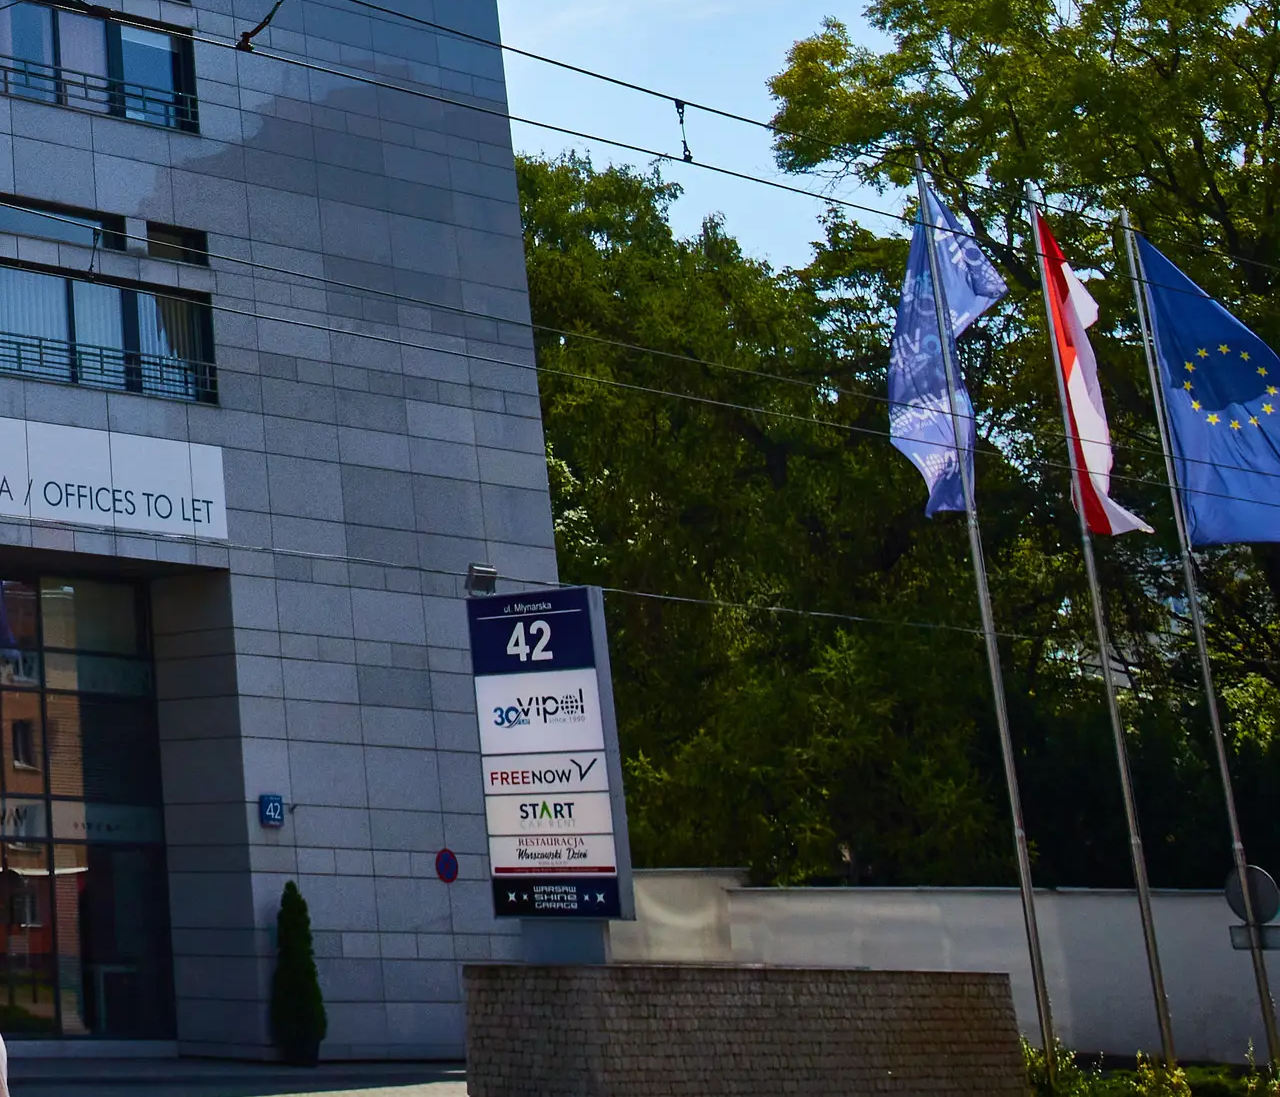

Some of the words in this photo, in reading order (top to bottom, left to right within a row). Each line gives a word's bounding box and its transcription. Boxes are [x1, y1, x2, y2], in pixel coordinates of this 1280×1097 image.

[43, 481, 136, 515] OFFICES
[142, 492, 173, 519] TO
[181, 497, 214, 524] LET
[506, 619, 554, 662] 42
[490, 769, 572, 786] FREENOW
[266, 802, 281, 819] 42
[519, 800, 575, 820] START
[518, 837, 585, 848] RESTAURACJA
[516, 848, 562, 861] Warszawski
